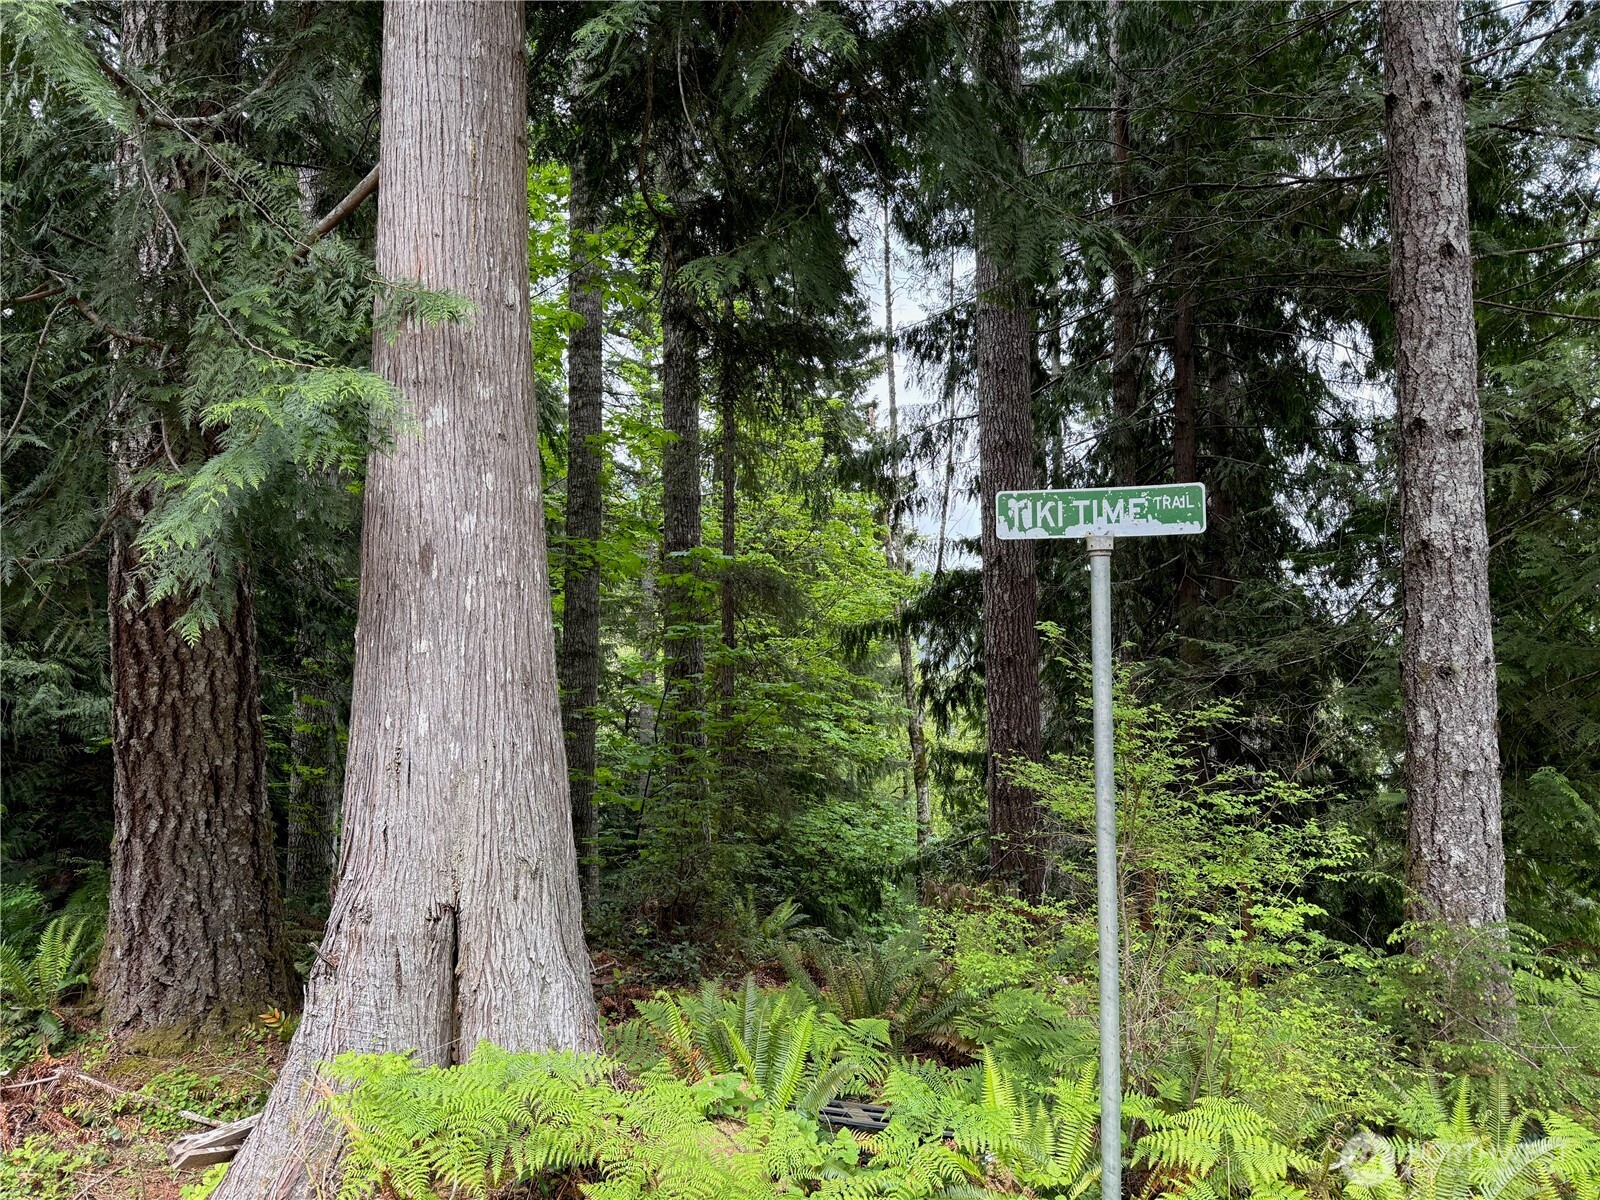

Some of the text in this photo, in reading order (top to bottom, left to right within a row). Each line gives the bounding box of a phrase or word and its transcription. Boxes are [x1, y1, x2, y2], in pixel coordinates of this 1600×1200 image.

[1008, 495, 1195, 528] TIKI TIME TRAIL
